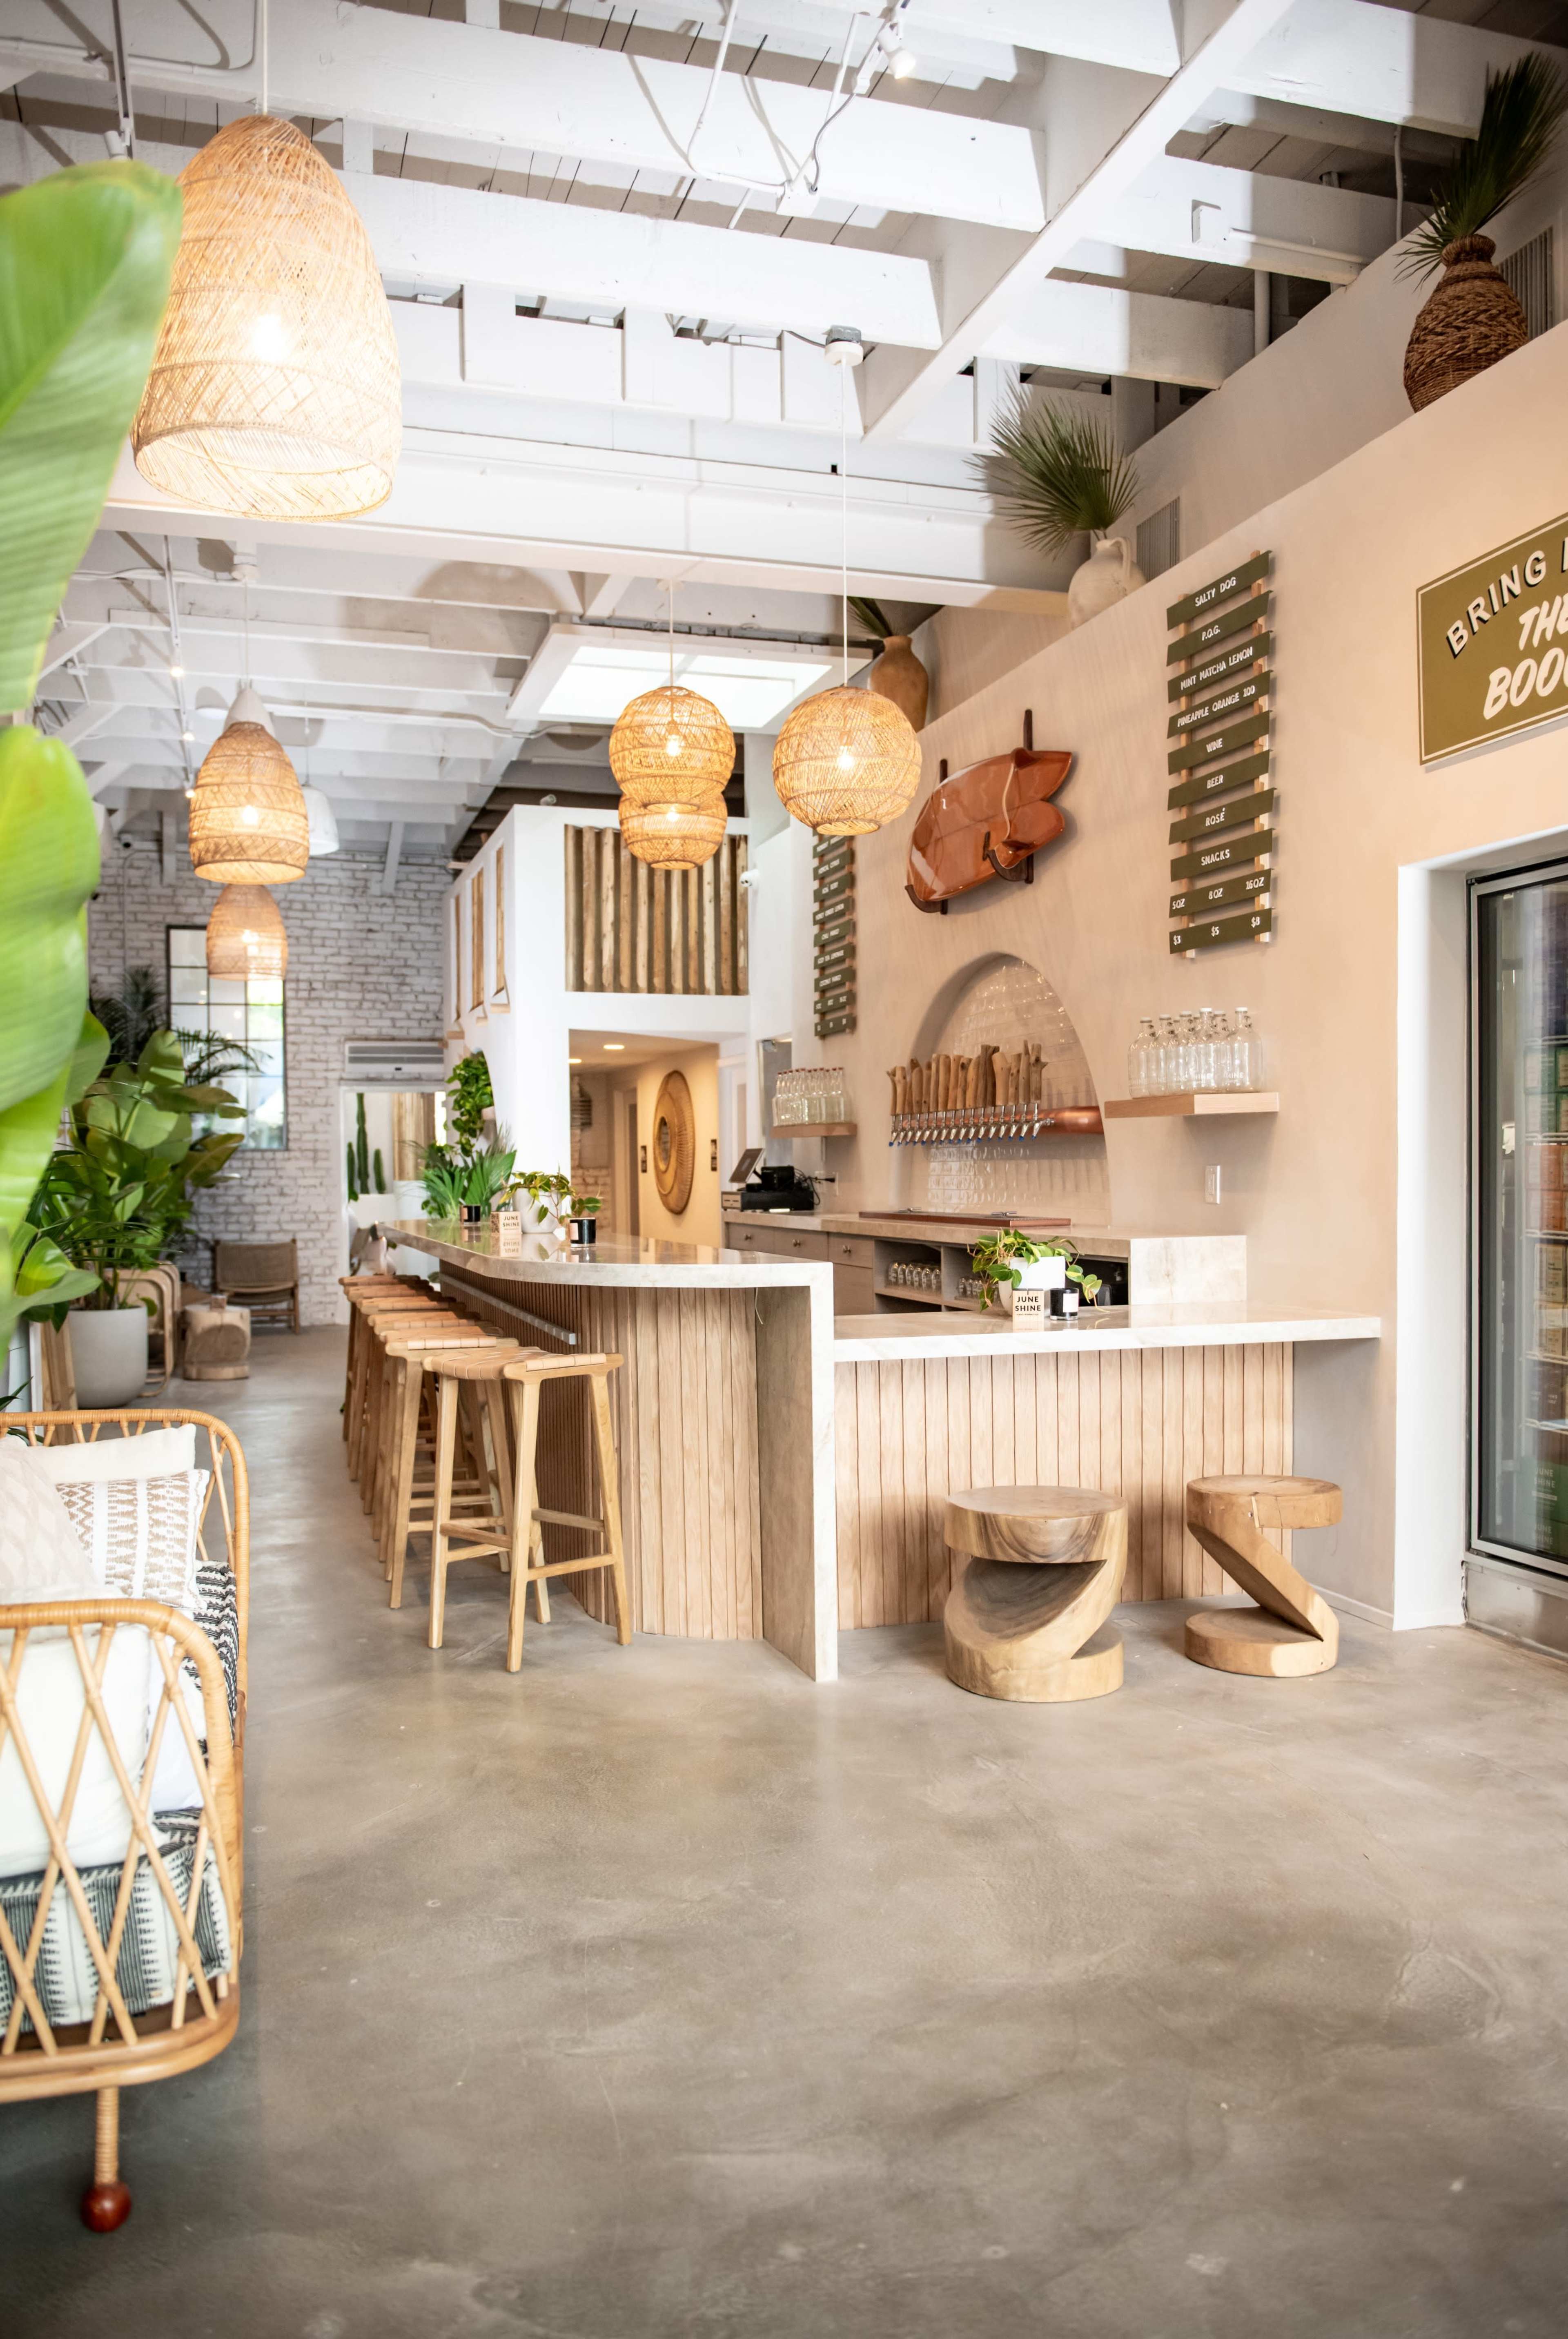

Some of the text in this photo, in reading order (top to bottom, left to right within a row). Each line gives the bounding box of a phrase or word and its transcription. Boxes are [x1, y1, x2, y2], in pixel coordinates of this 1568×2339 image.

[1195, 577, 1236, 606] SALTY DOG
[1446, 550, 1546, 659] BRING
[1202, 625, 1220, 640] P.O.G.
[1180, 647, 1253, 690] MINT MATCHA LEMON
[1483, 647, 1568, 720] BOO
[1177, 685, 1255, 727] PINEAPPLE ORANGE 100
[1206, 738, 1223, 752] WINE
[1207, 775, 1223, 789] BEER
[1201, 849, 1230, 865] SNACKS
[1173, 916, 1261, 945] $3 $5 $8
